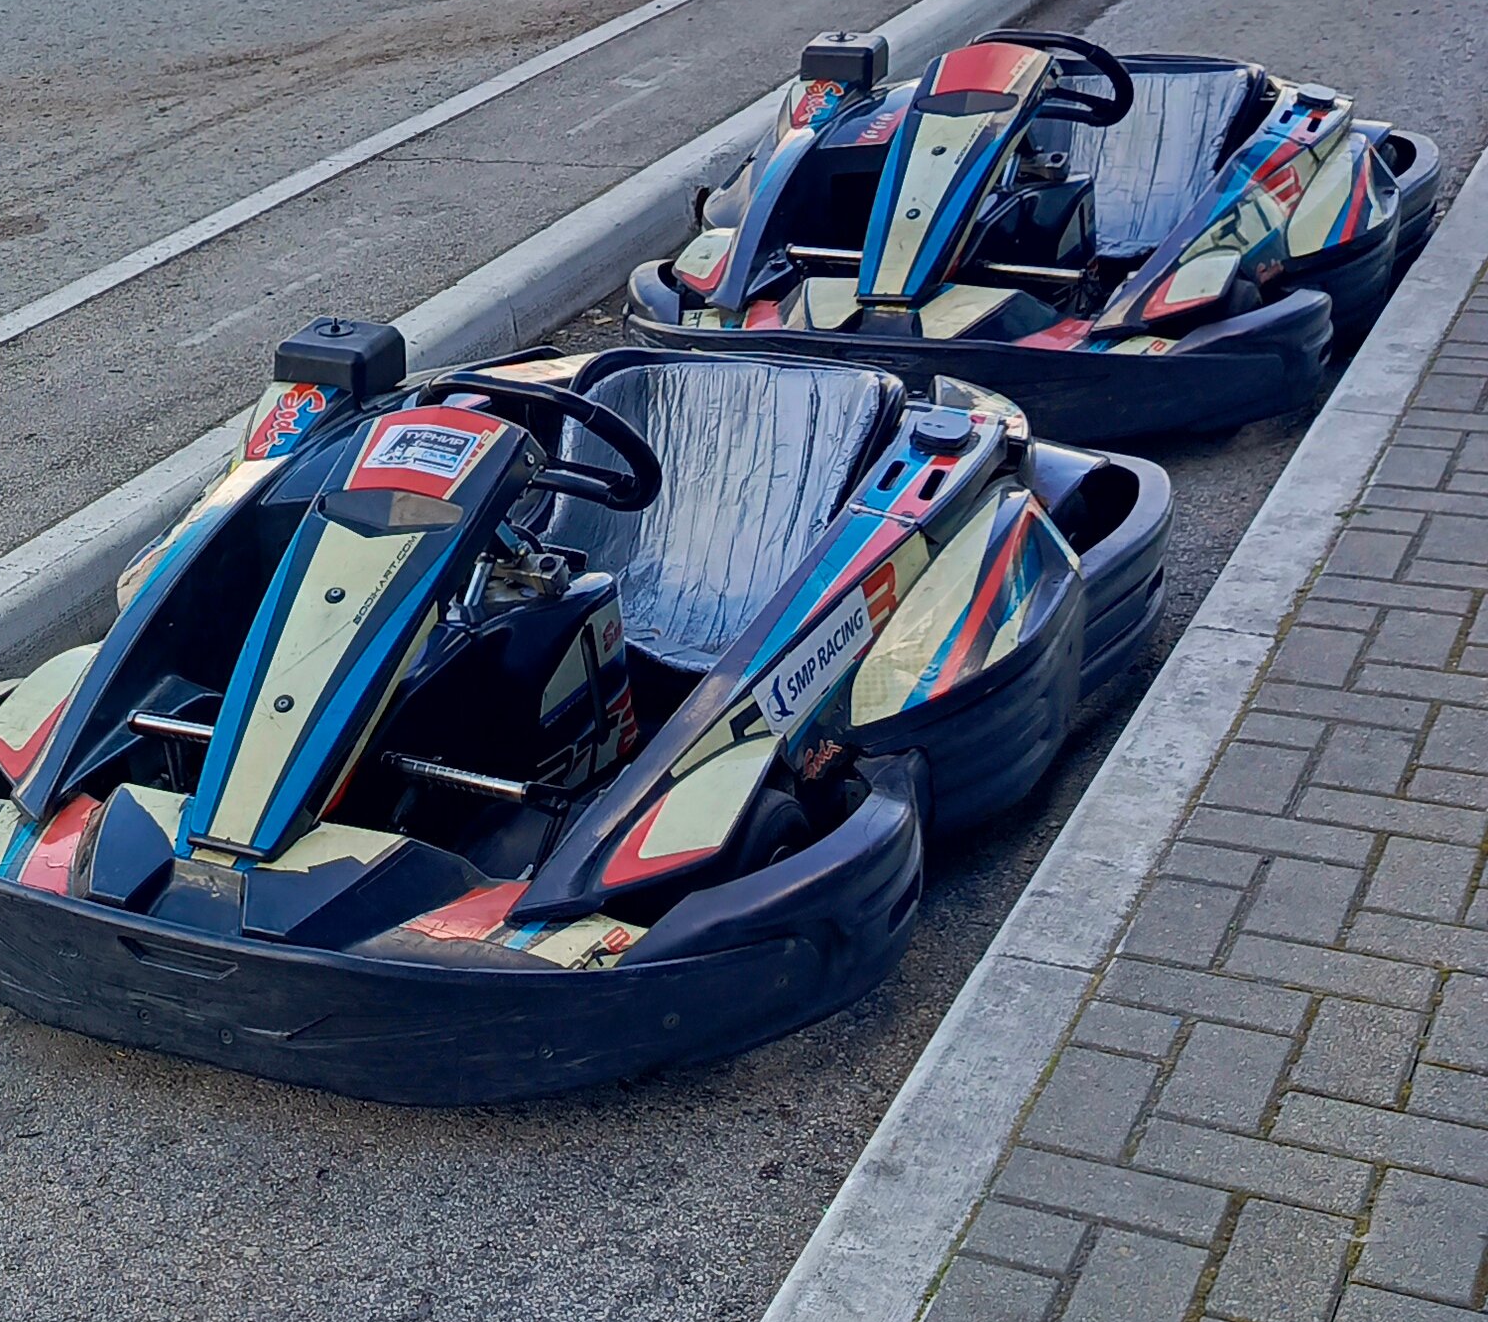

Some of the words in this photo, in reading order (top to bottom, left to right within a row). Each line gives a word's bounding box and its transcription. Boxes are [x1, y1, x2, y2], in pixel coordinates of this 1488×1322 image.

[253, 385, 326, 454] Sodi
[405, 431, 465, 446] ТУРНИР
[786, 658, 817, 702] SMP
[818, 607, 864, 672] RACING
